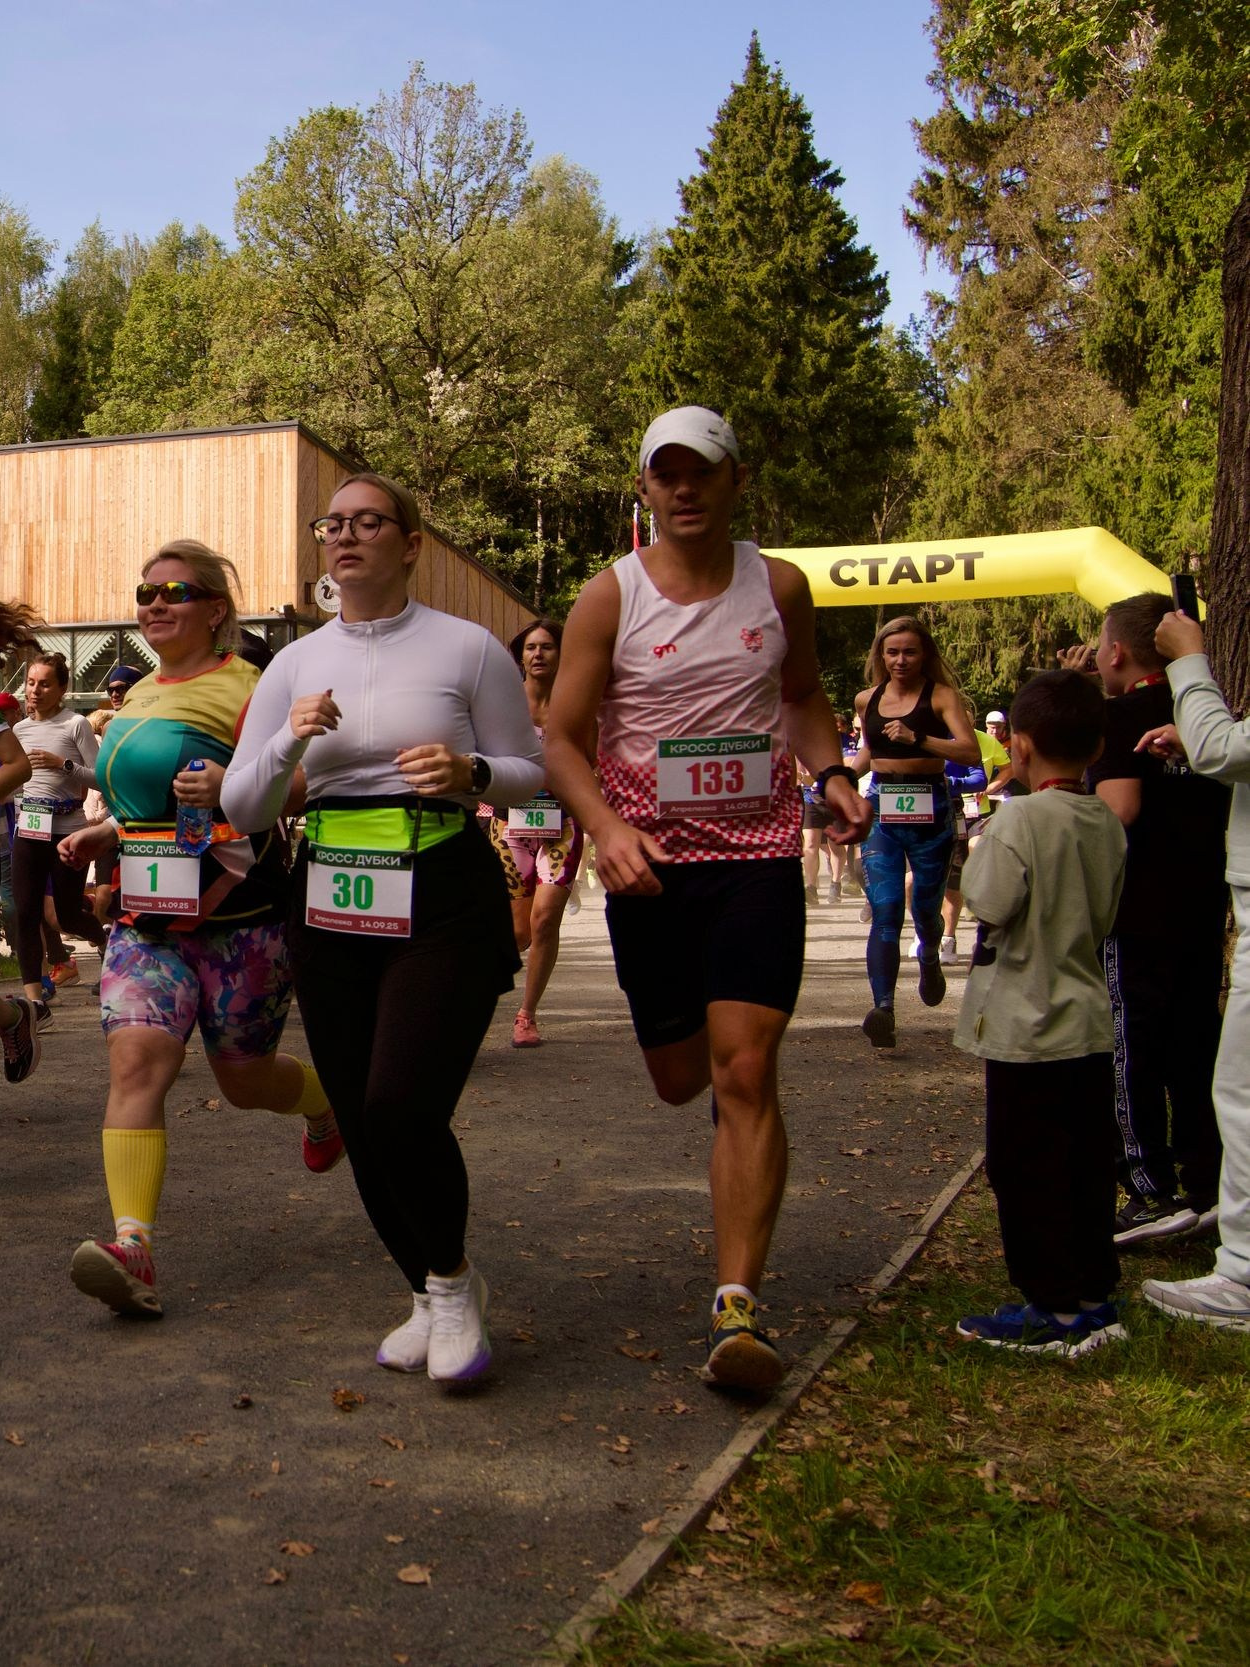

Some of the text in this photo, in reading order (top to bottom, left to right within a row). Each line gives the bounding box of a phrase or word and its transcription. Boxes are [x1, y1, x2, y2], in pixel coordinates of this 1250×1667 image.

[830, 551, 984, 587] СТАРТ
[670, 740, 760, 753] КРОСС ДУБКИ
[686, 760, 744, 795] 133
[725, 801, 760, 811] 14.09.25
[896, 796, 915, 812] 42
[27, 815, 41, 830] 35
[525, 811, 545, 827] 48
[155, 845, 186, 855] ДУБК
[316, 850, 401, 866] КРОСС ДУБКИ
[146, 863, 158, 892] 1
[333, 872, 374, 910] 30
[158, 901, 189, 909] 14.09.25
[360, 920, 399, 930] 14.09.25
